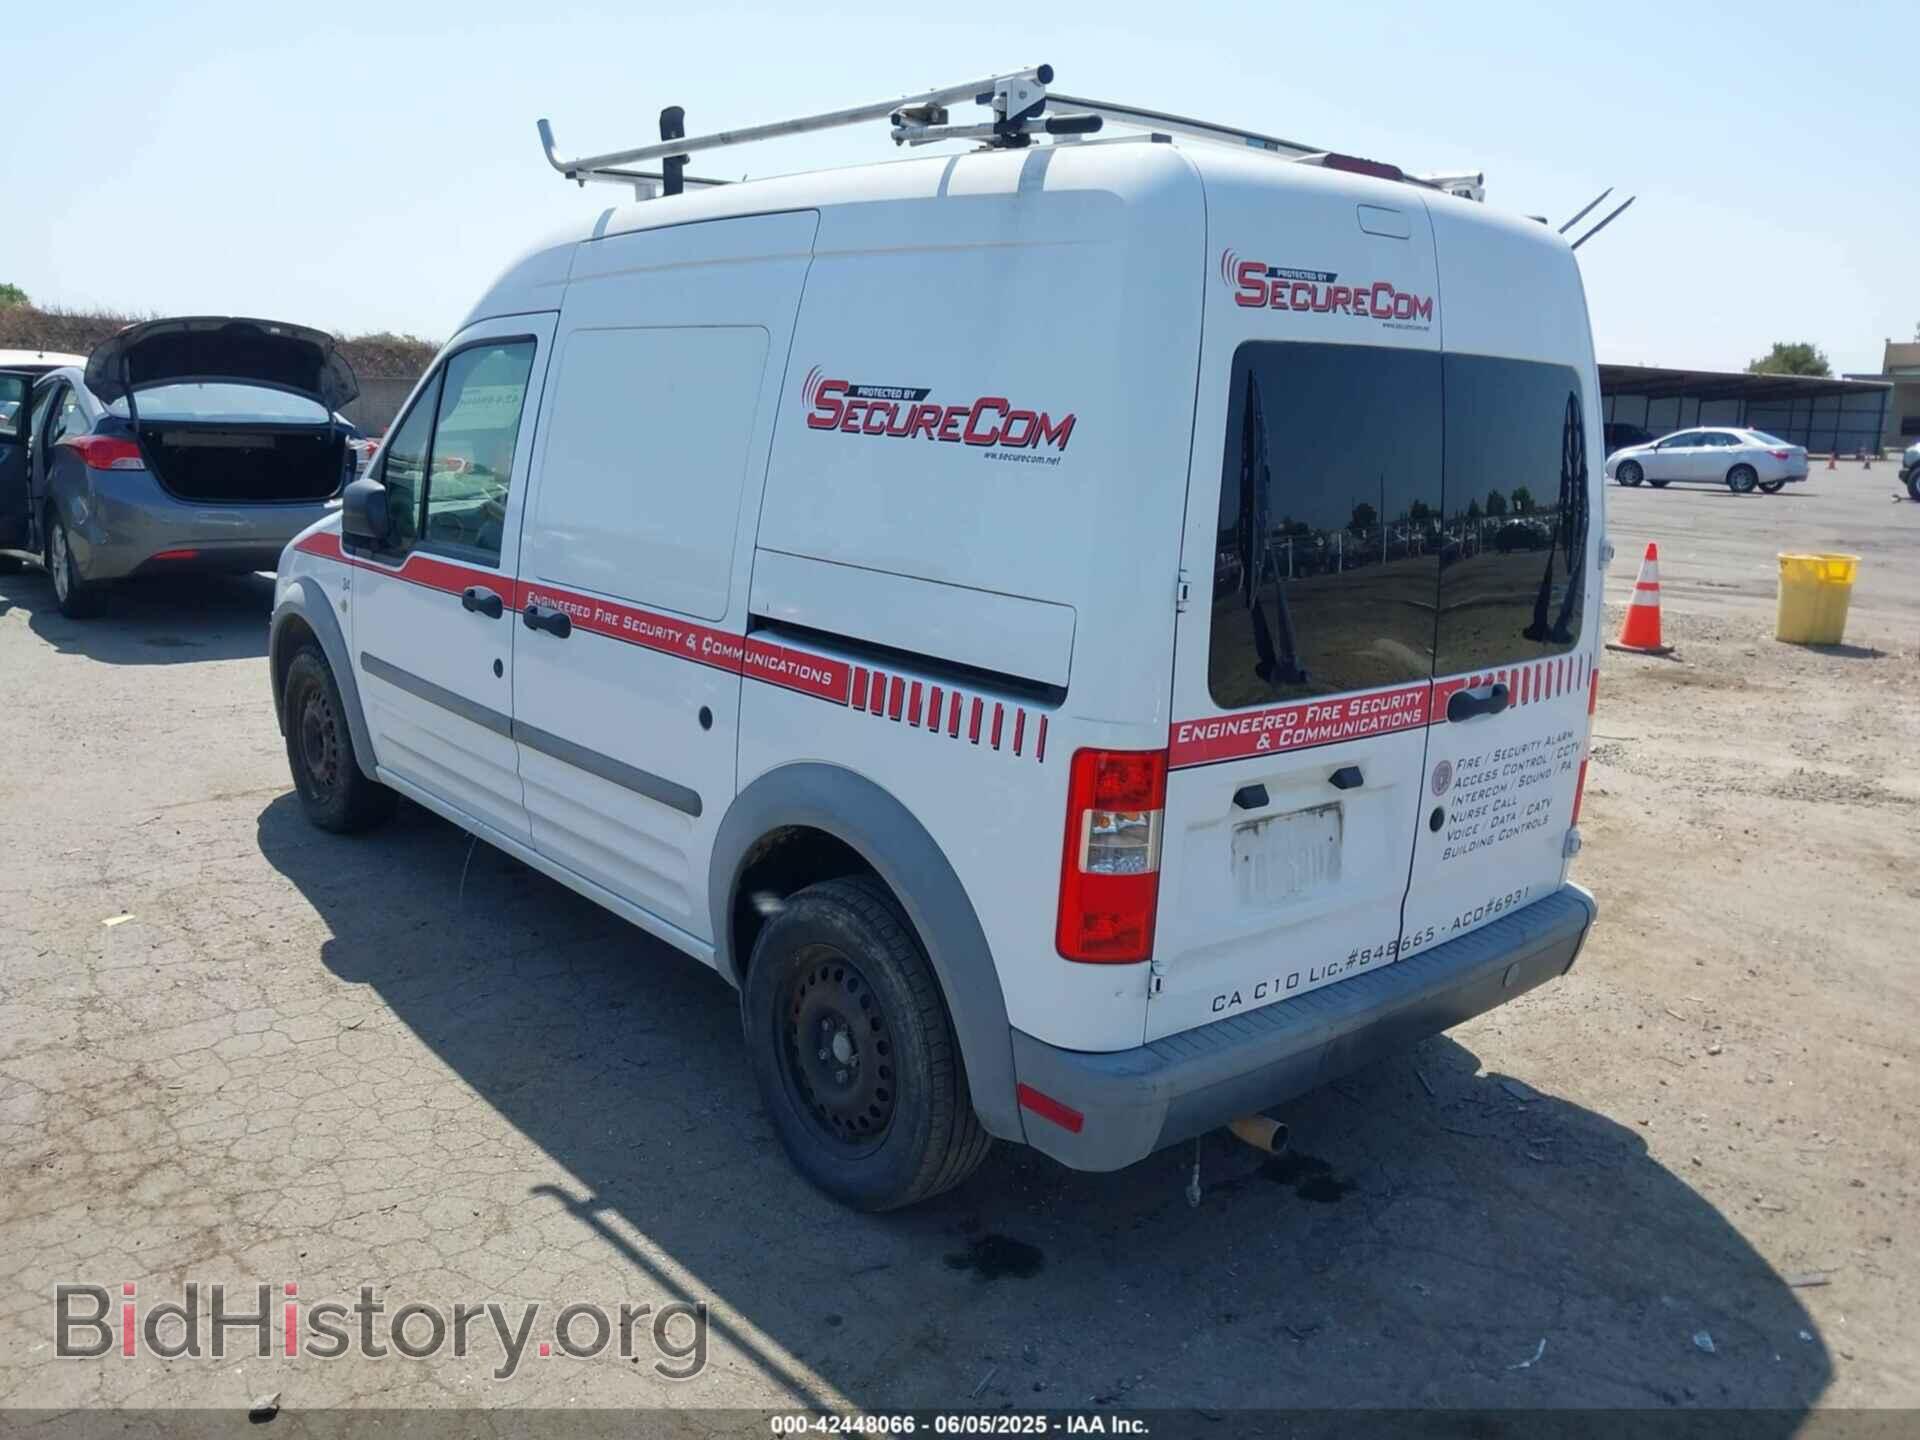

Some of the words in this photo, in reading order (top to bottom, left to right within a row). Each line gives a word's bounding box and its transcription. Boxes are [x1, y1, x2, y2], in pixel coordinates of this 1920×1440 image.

[857, 386, 902, 399] PROTECTED
[903, 390, 916, 399] BY
[594, 608, 618, 626] FIRE
[623, 616, 681, 642] SECURITY
[686, 633, 697, 651] &
[702, 636, 833, 686] COMMUNICATIONS
[1177, 711, 1299, 743] ENGINEERED
[1305, 705, 1342, 722] FIRE
[1348, 690, 1423, 716] SECURITY
[1256, 733, 1271, 750] &
[1279, 708, 1422, 746] COMMUNICATIONS
[1456, 756, 1482, 771] FIRE
[1493, 739, 1542, 762] SECURITY
[1544, 729, 1574, 748] ALARM
[1451, 783, 1509, 808] INTERCOM
[1518, 767, 1552, 788] SOUND
[1454, 768, 1499, 790] ACCESS
[1502, 754, 1547, 777] CONTROL
[1447, 822, 1480, 842] VOICE
[1490, 812, 1517, 829] DATA
[1448, 804, 1488, 825] NURSE
[1492, 797, 1518, 812] CALL
[1442, 834, 1495, 861] BUILDING
[1498, 813, 1549, 841] CONTROLS
[1212, 990, 1242, 1013] CA
[1254, 972, 1300, 1000] C10
